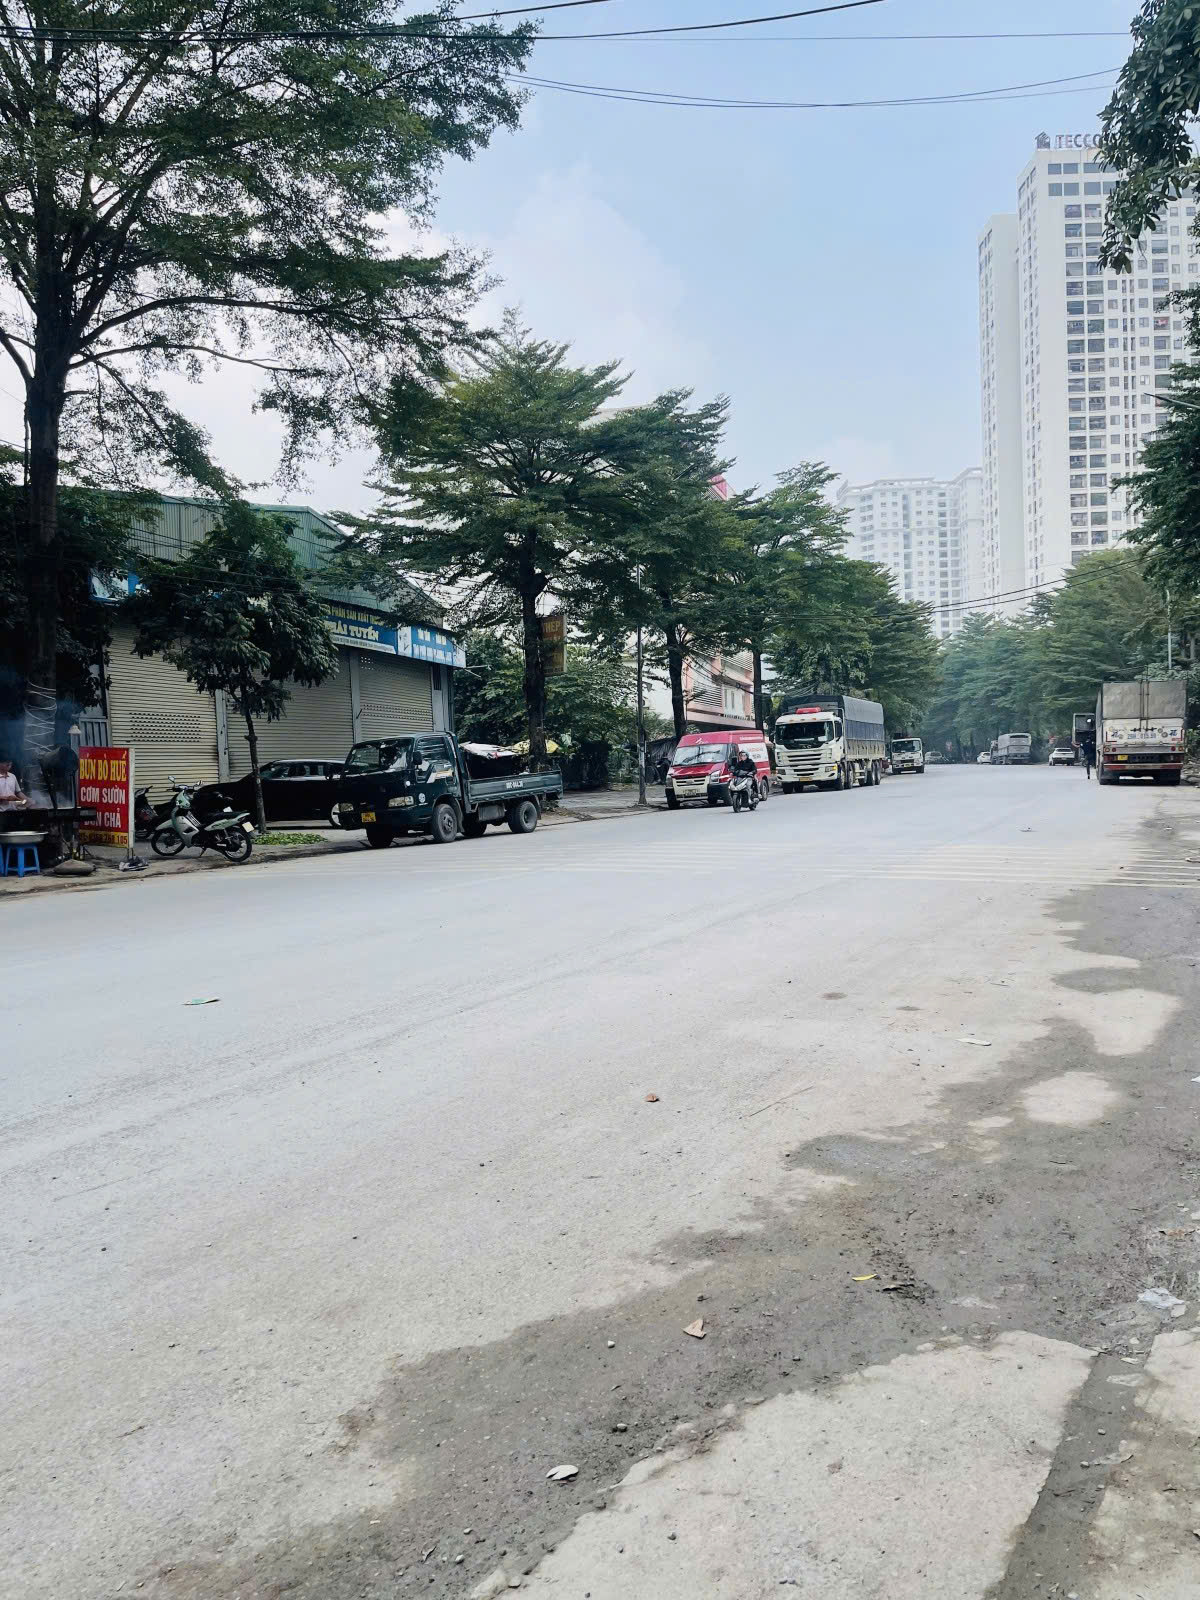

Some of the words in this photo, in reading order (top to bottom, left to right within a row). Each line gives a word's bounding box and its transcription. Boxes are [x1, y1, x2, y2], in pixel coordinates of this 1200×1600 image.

[80, 753, 96, 780] BÚN
[98, 753, 109, 781] BÒ
[110, 750, 128, 782] HUẾ
[81, 786, 100, 803] CƠM
[102, 784, 126, 805] SƯỜN
[104, 807, 122, 828] CHẢ
